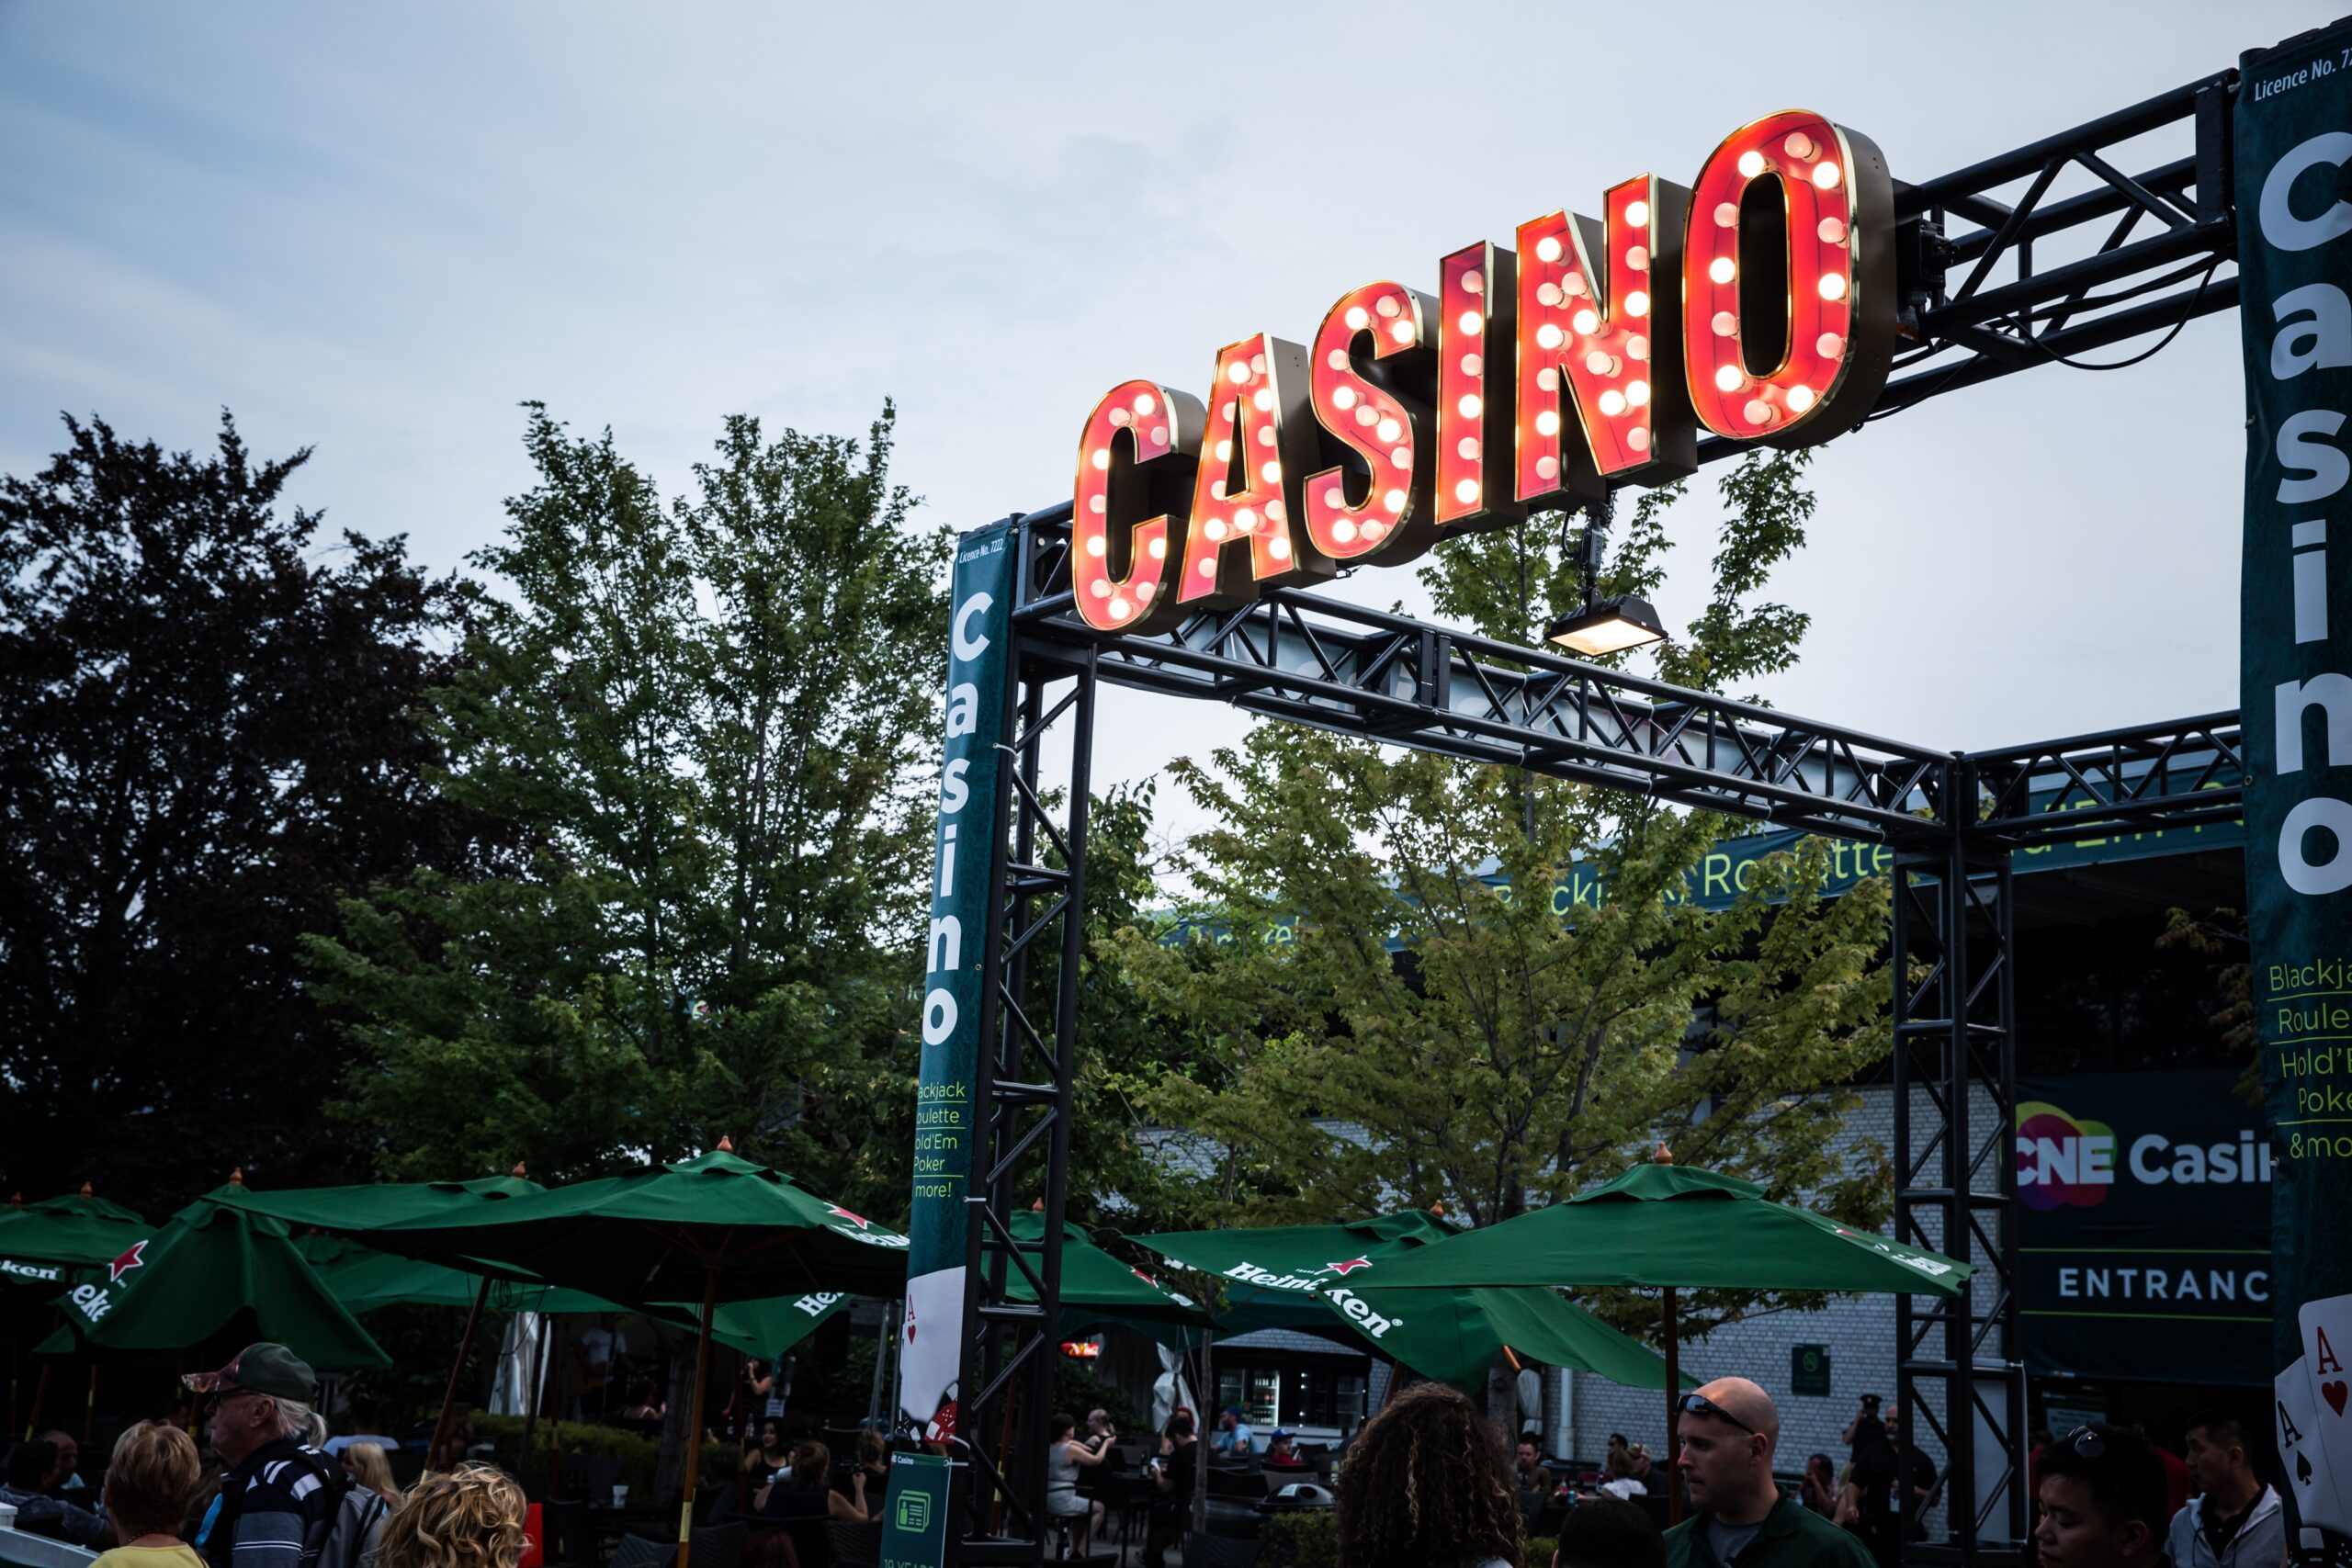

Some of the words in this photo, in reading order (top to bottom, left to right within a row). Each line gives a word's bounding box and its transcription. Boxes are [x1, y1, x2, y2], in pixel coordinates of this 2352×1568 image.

[2255, 69, 2308, 102] Licence
[2312, 58, 2336, 80] No.
[2342, 46, 2352, 69] 7
[1071, 107, 1865, 632] CASINO
[2259, 131, 2352, 895] Casino
[959, 549, 979, 564] Licence
[922, 592, 994, 1046] Casino
[914, 1155, 945, 1172] Poker
[2016, 1134, 2115, 1187] CNE
[915, 1181, 952, 1198] more!
[793, 1292, 844, 1317] He
[908, 1294, 916, 1321] A
[2059, 1267, 2269, 1303] ENTRANC
[2317, 1326, 2343, 1375] A
[2278, 1401, 2302, 1449] A
